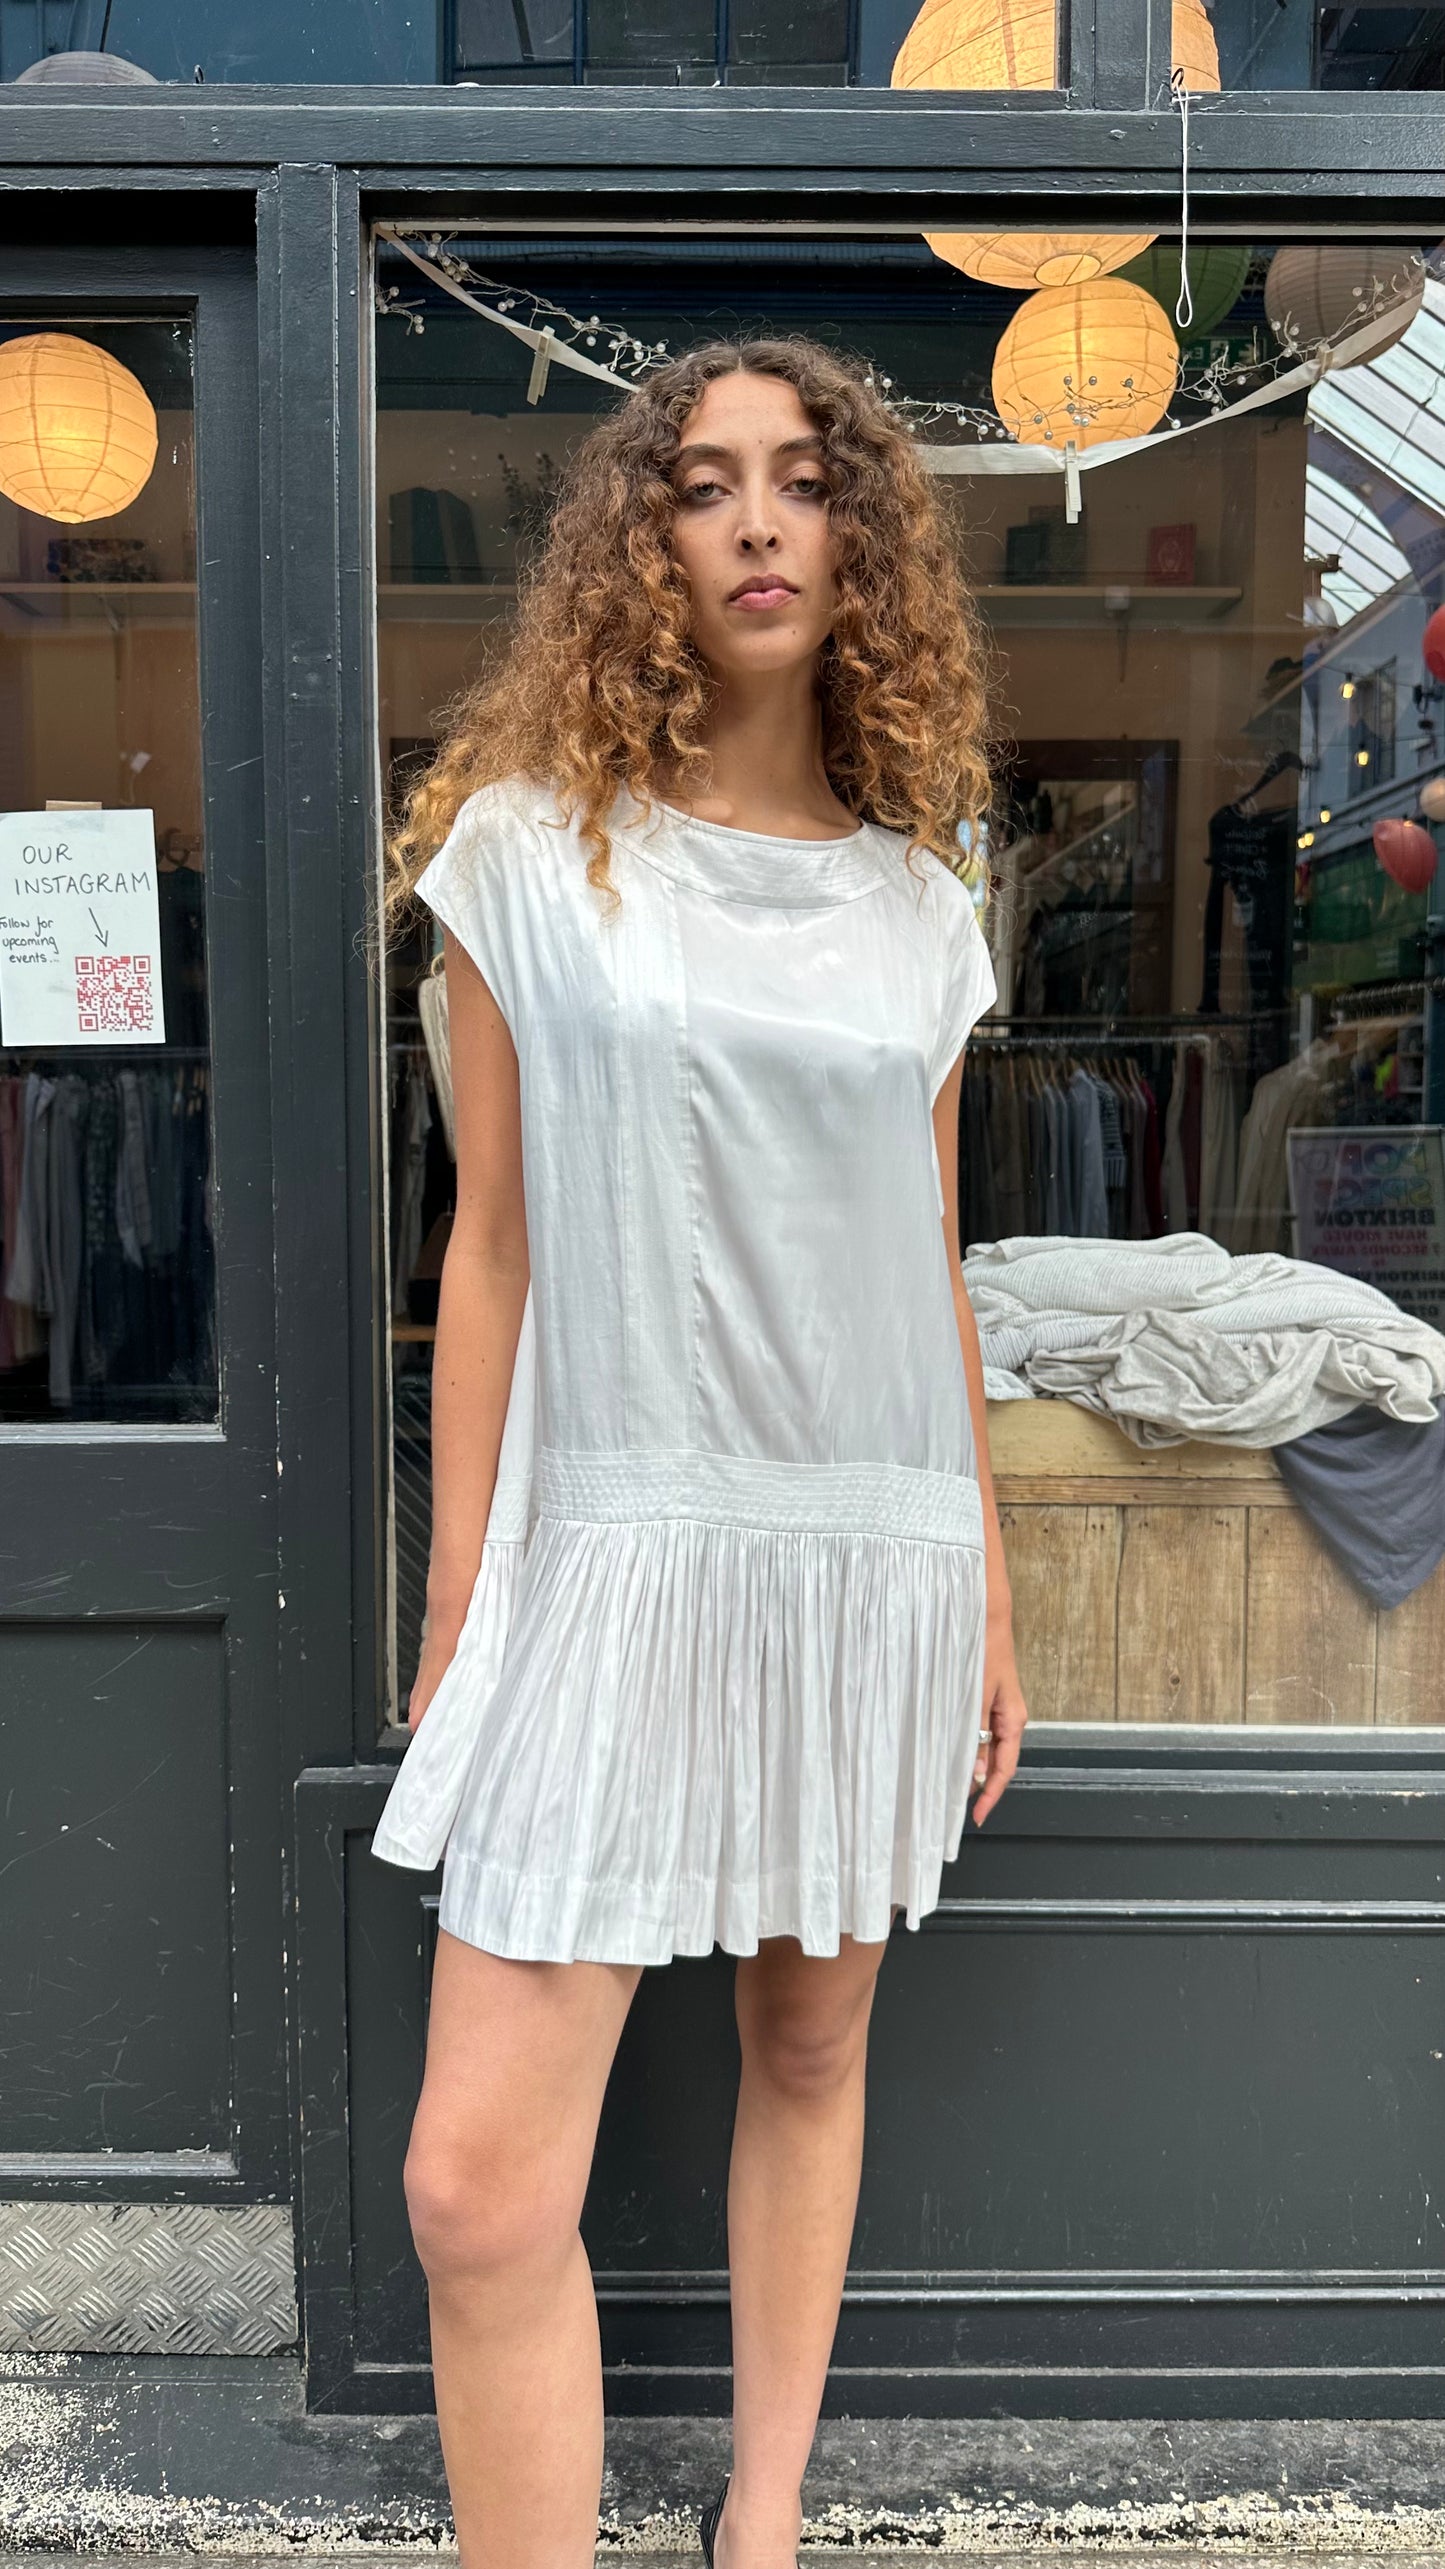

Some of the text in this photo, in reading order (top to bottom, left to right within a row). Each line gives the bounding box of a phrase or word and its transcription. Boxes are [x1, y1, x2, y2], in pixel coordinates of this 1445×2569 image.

[23, 843, 73, 865] OUR
[14, 871, 151, 895] INSTAGRAM
[34, 915, 54, 937] for
[2, 936, 60, 955] upcoming
